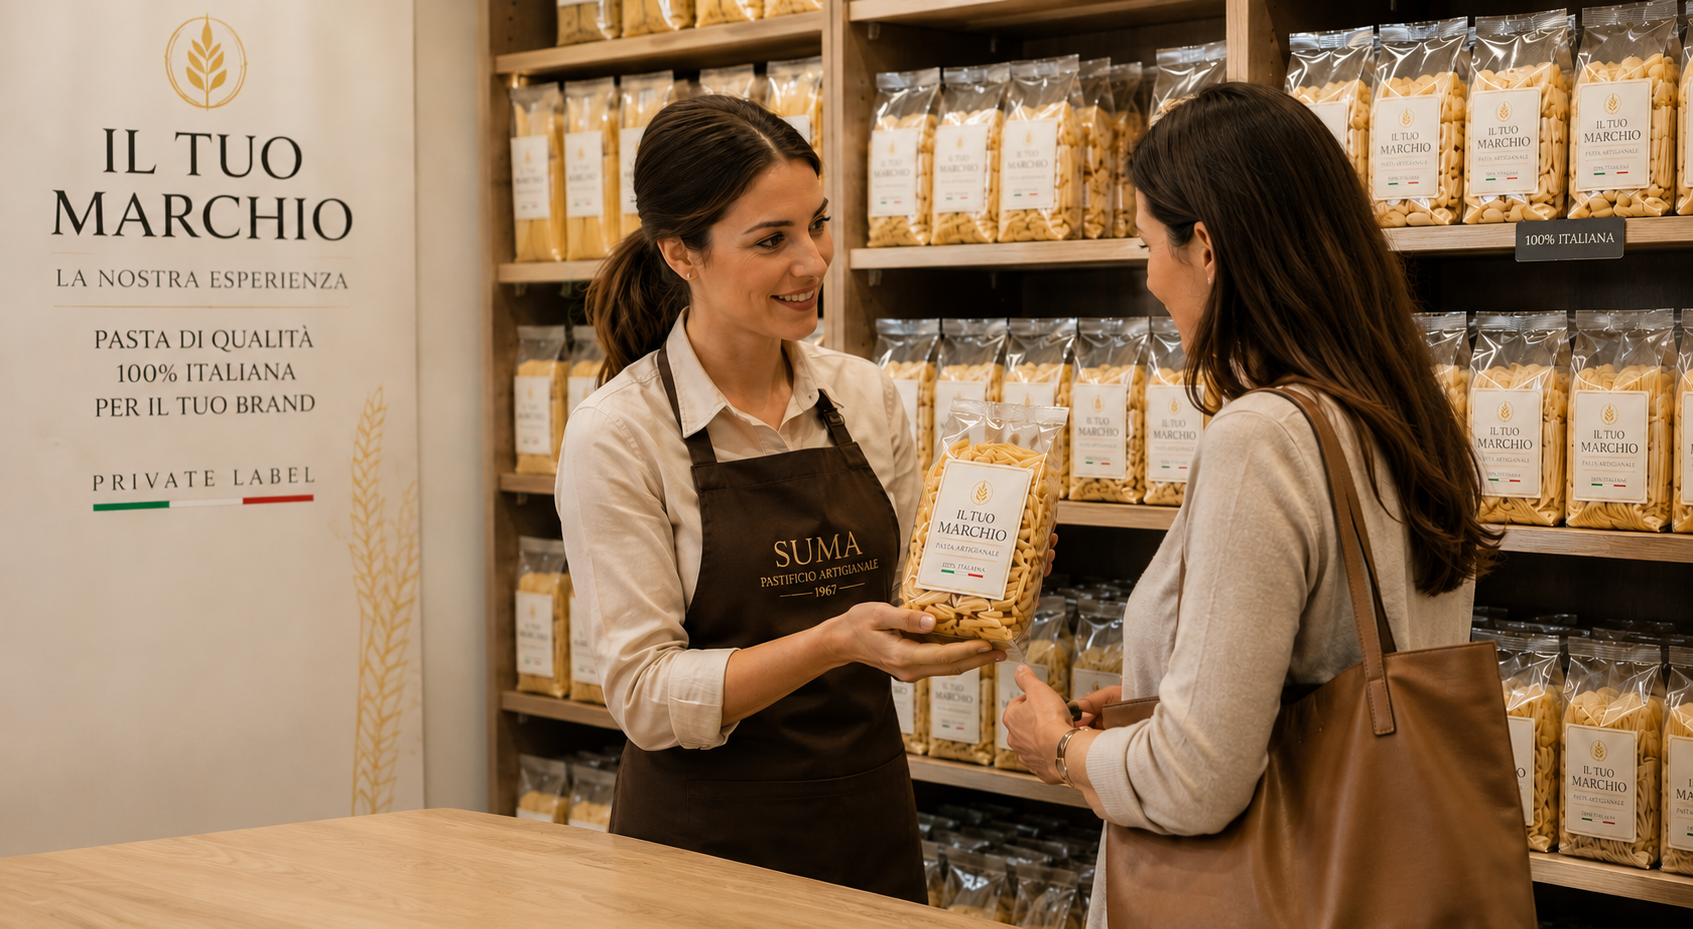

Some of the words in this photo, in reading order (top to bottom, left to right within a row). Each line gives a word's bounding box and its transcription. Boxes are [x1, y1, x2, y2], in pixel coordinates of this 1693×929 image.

[1488, 127, 1497, 136] IL
[1498, 125, 1519, 136] TUO
[1596, 120, 1605, 129] IL
[1606, 118, 1628, 129] TUO
[1401, 131, 1420, 141] TUO
[1477, 136, 1531, 150] MARCHIO
[1584, 129, 1641, 143] MARCHIO
[102, 127, 157, 175] IL
[174, 131, 303, 180] TUO
[1380, 142, 1432, 156] MARCHIO
[51, 189, 353, 241] MARCHIO
[1525, 234, 1555, 246] 100%
[1558, 232, 1615, 245] ITALIANA
[56, 269, 88, 288] LA
[97, 269, 200, 289] NOSTRA
[209, 270, 349, 290] ESPERIENZA
[94, 329, 172, 350] PASTA
[179, 329, 204, 349] DI
[211, 325, 314, 353] QUALITÀ
[116, 363, 178, 384] 100%
[186, 362, 297, 383] ITALIANA
[95, 397, 141, 418] PER
[148, 396, 170, 417] IL
[176, 395, 228, 416] TUO
[235, 393, 316, 415] BRAND
[1078, 427, 1119, 437] MARCHIO
[1153, 430, 1197, 440] MARCHIO
[1490, 426, 1499, 436] IL
[1500, 427, 1520, 437] TUO
[1593, 429, 1602, 440] IL
[1603, 429, 1626, 441] TUO
[1477, 438, 1533, 451] MARCHIO
[1581, 441, 1639, 455] MARCHIO
[92, 470, 216, 492] PRIVATE
[233, 466, 316, 487] LABEL
[956, 509, 968, 521] IL
[970, 510, 996, 525] TUO
[937, 521, 1008, 543] MARCHIO
[774, 531, 863, 568] SUMA
[760, 570, 817, 588] PASTIFICIO
[818, 558, 879, 580] ARTIGIANALE
[814, 584, 838, 598] 1967
[1583, 765, 1592, 775] IL
[1593, 766, 1615, 778] TUO
[1572, 775, 1627, 793] MARCHIO
